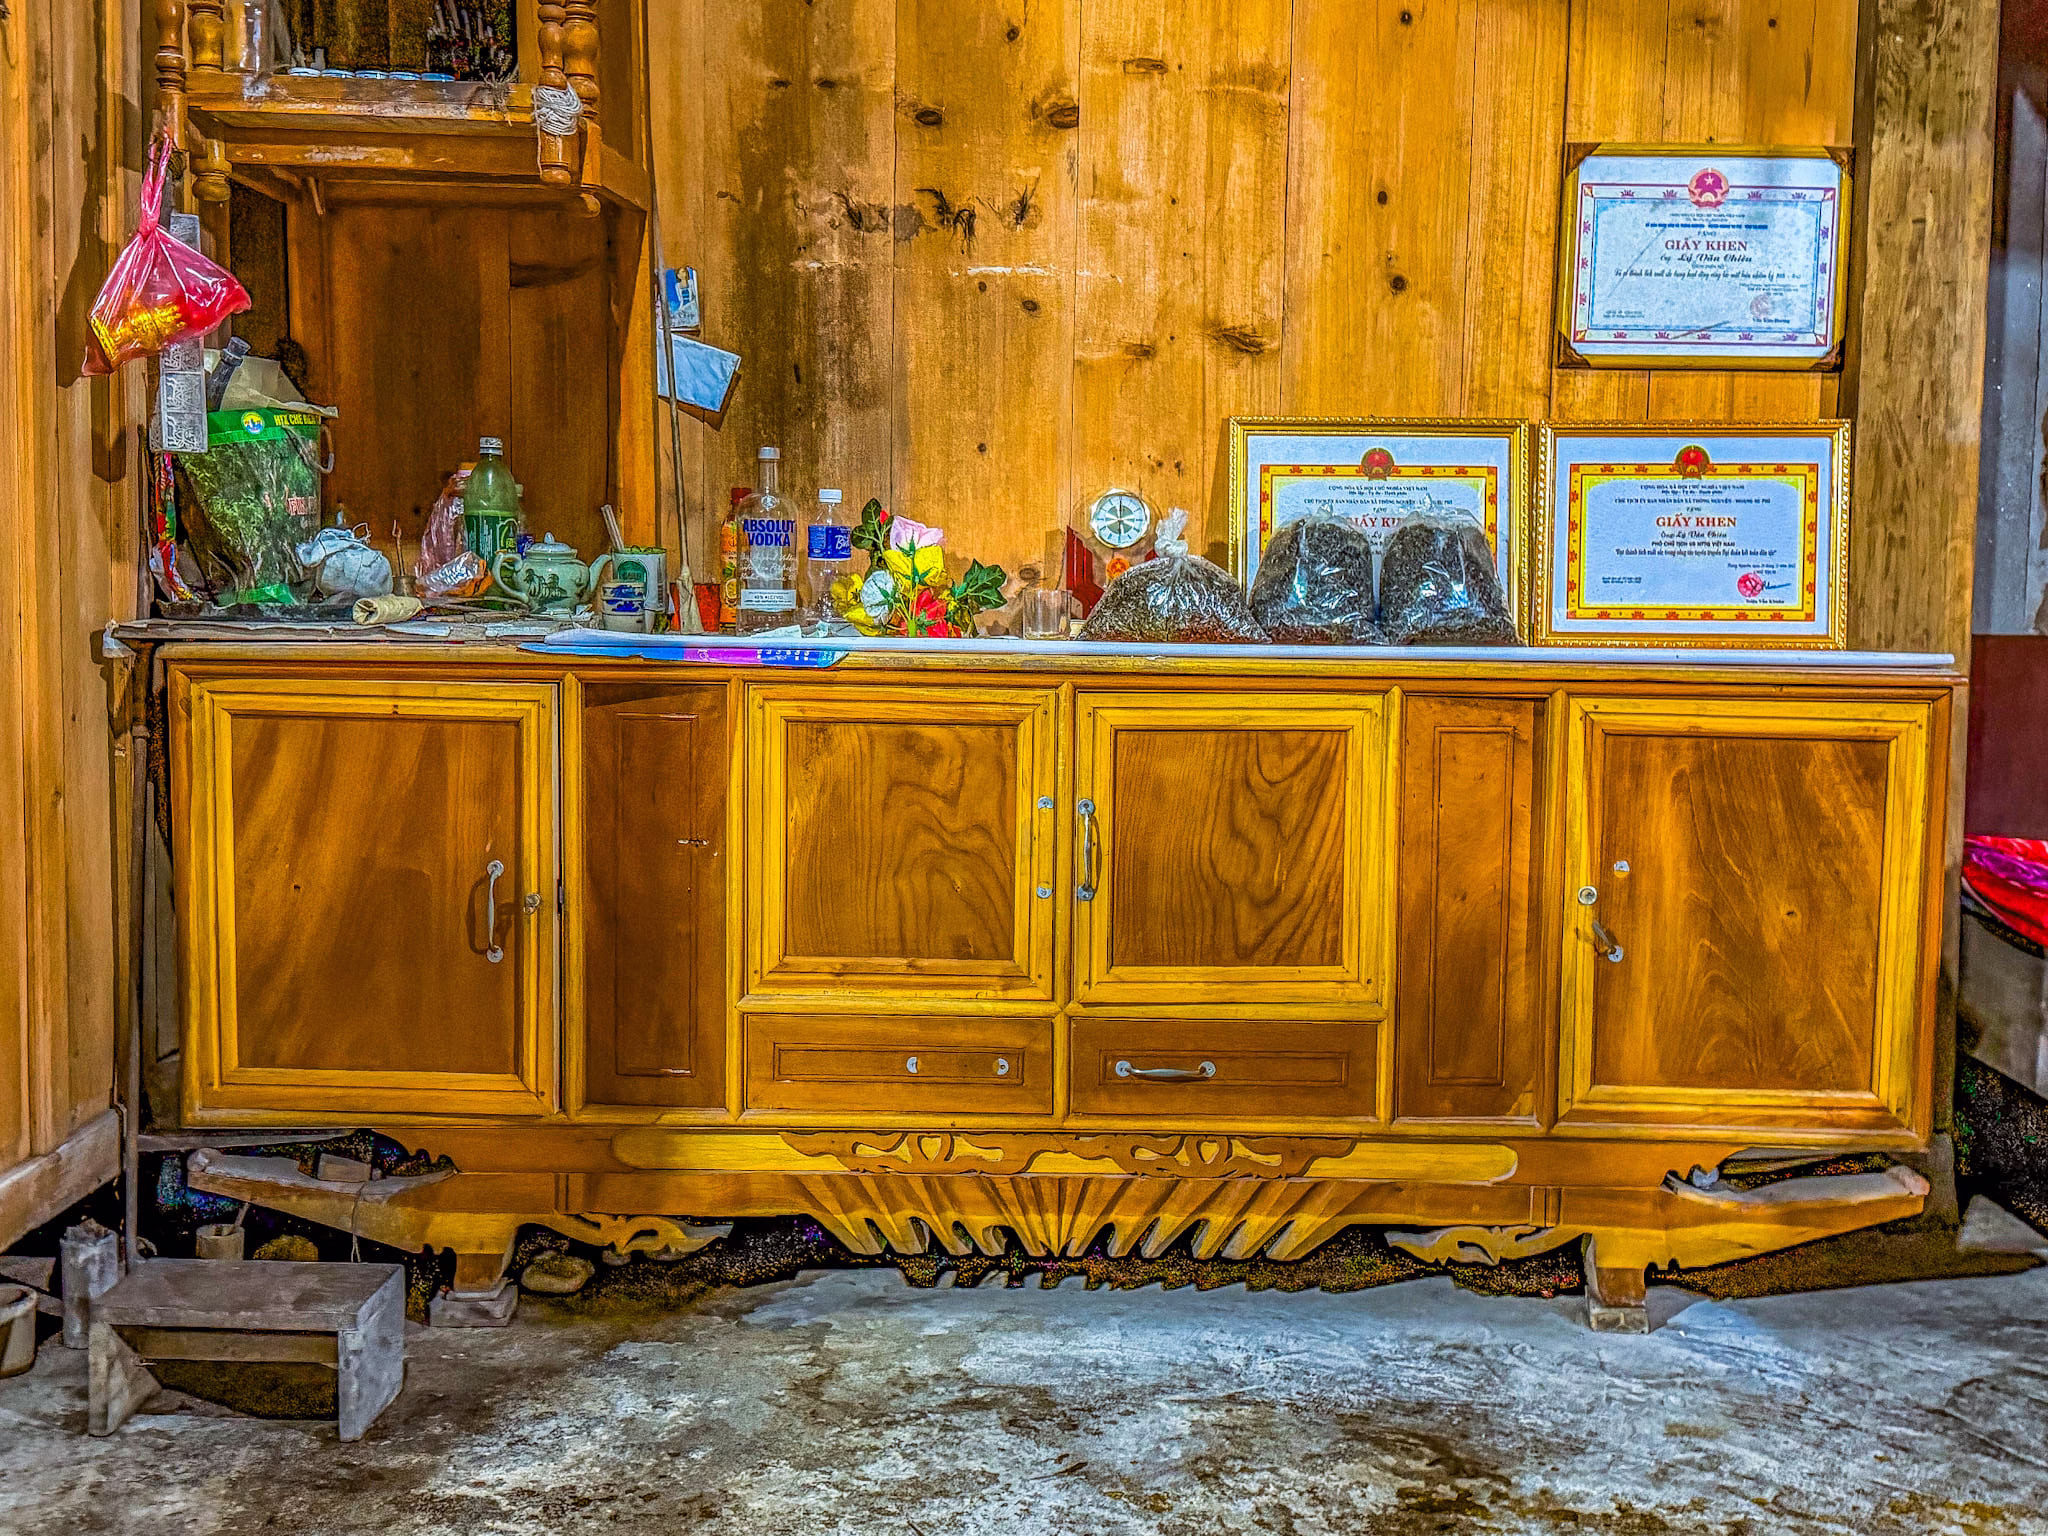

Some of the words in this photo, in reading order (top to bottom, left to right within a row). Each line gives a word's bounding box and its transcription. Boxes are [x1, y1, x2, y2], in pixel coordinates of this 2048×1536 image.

[1706, 240, 1748, 252] KHEN
[743, 519, 796, 533] ABSOLUT
[1656, 512, 1691, 527] GIẤY
[1695, 516, 1737, 528] KHEN
[747, 532, 791, 547] VODKA
